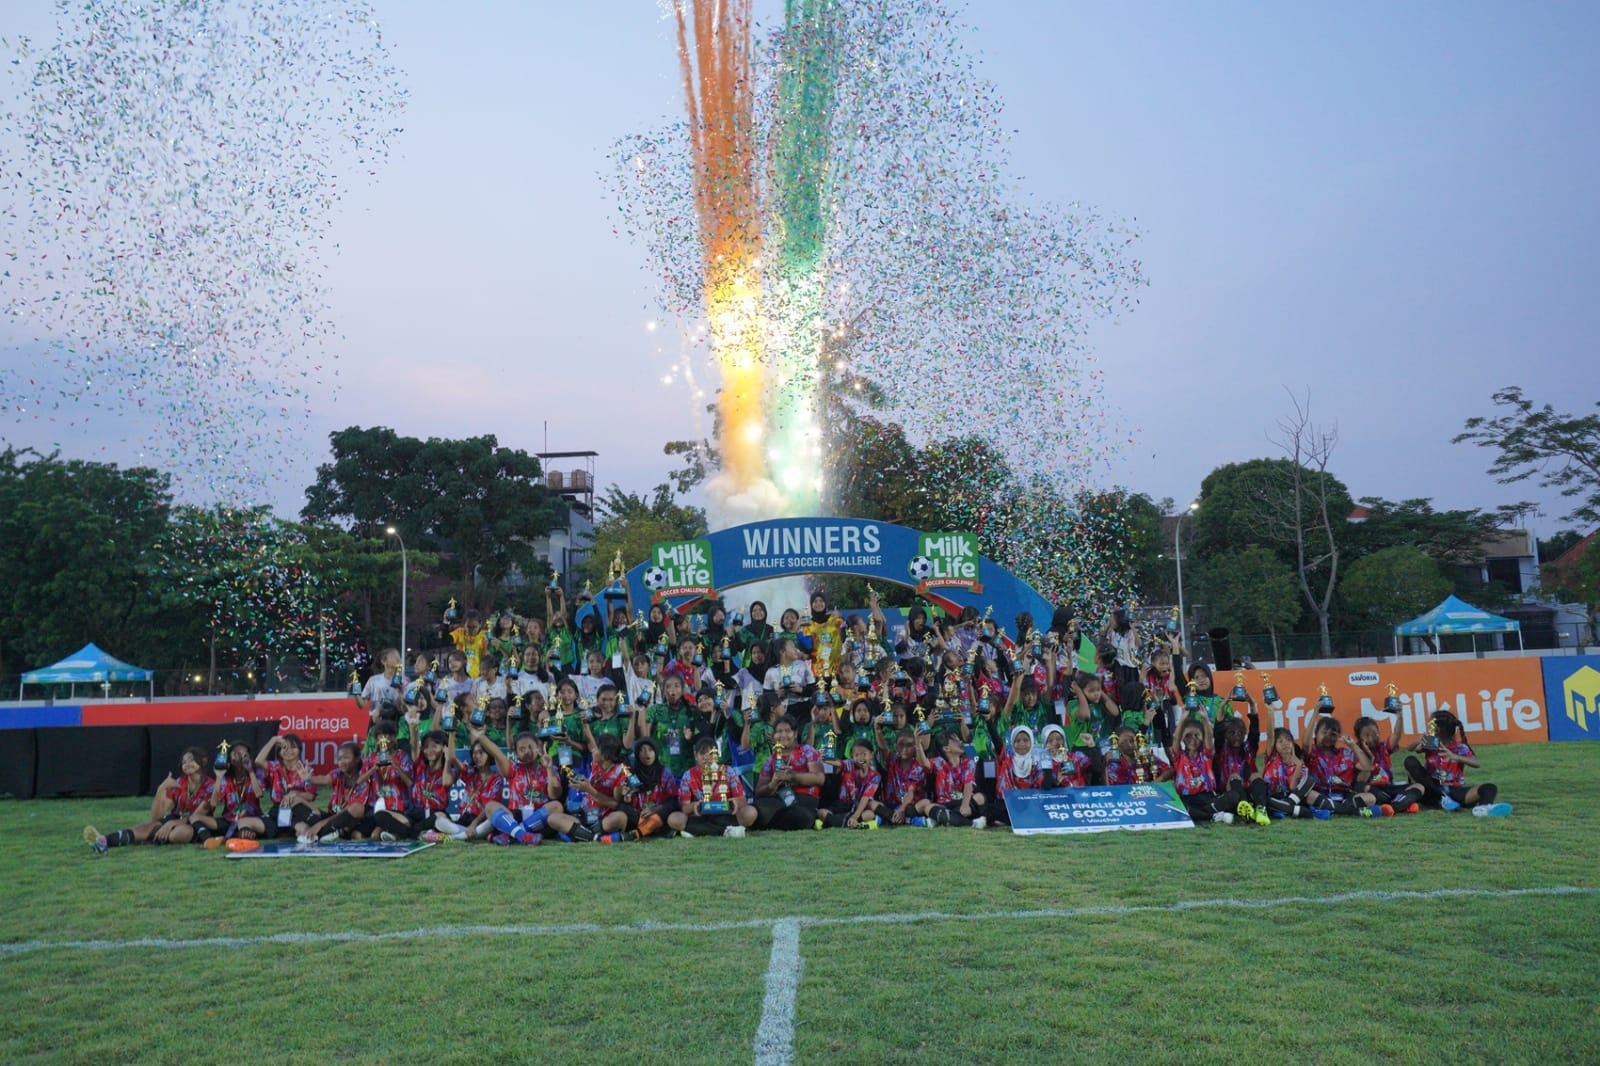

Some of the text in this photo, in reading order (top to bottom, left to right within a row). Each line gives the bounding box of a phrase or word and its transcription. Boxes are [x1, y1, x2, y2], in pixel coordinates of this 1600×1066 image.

[742, 525, 881, 555] WINNERS
[925, 535, 973, 557] Milk
[658, 543, 707, 567] Milk
[742, 555, 882, 568] MILKLIFE SOCCER CHALLENGE
[667, 564, 710, 587] Life
[933, 556, 976, 578] Life
[660, 587, 709, 597] SOCCER CHALLENGE
[279, 715, 349, 733] Olahraga
[1043, 803, 1070, 811] SEMI
[1048, 807, 1148, 820] Rp 600.000
